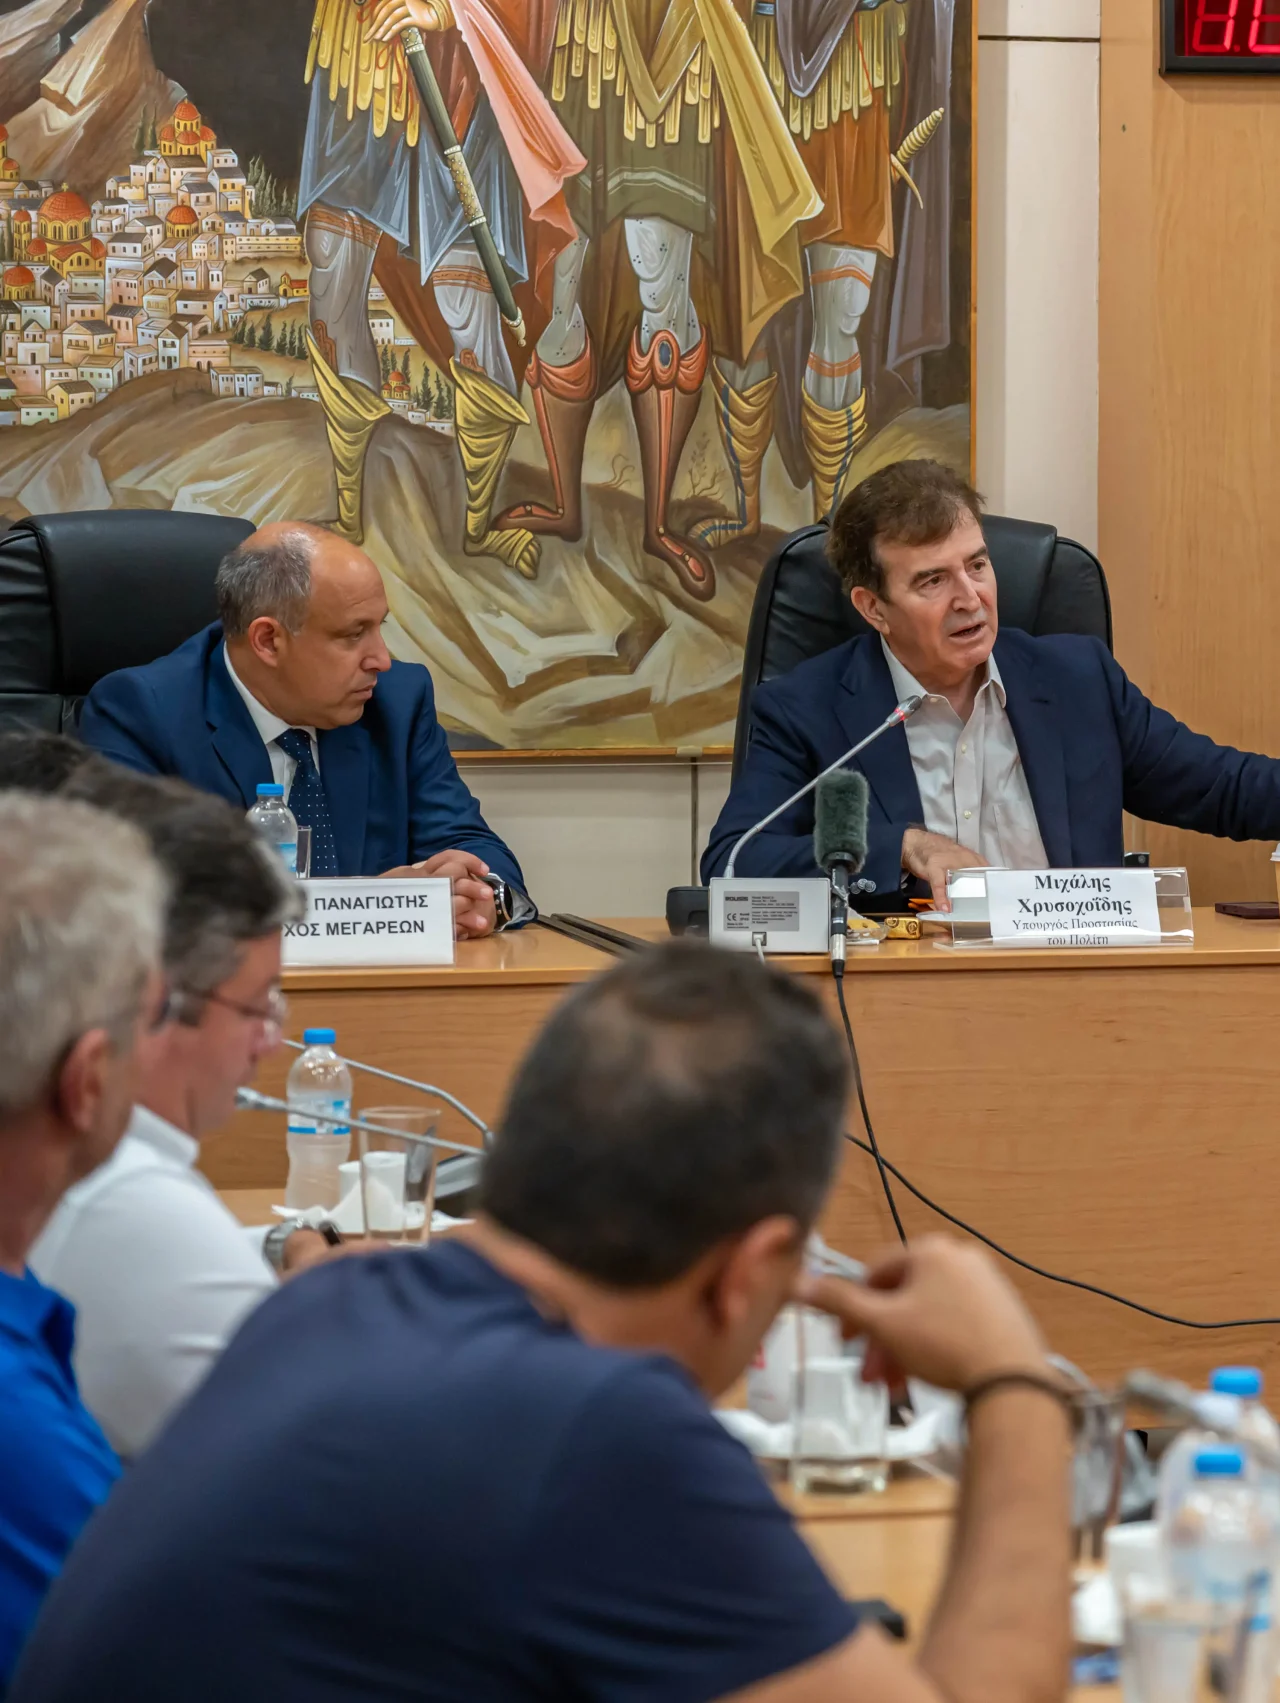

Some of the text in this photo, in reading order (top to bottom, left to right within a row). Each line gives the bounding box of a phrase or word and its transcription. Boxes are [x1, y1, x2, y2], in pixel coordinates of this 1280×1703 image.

[1035, 874, 1111, 893] Μιχάλης
[314, 895, 428, 911] ΠΑΝΑΓΙΩΤΗΣ
[284, 920, 425, 937] ΧΟΣ ΜΕΓΑΡΕΩΝ
[1012, 919, 1069, 931] Υπουργός
[1047, 936, 1066, 945] του
